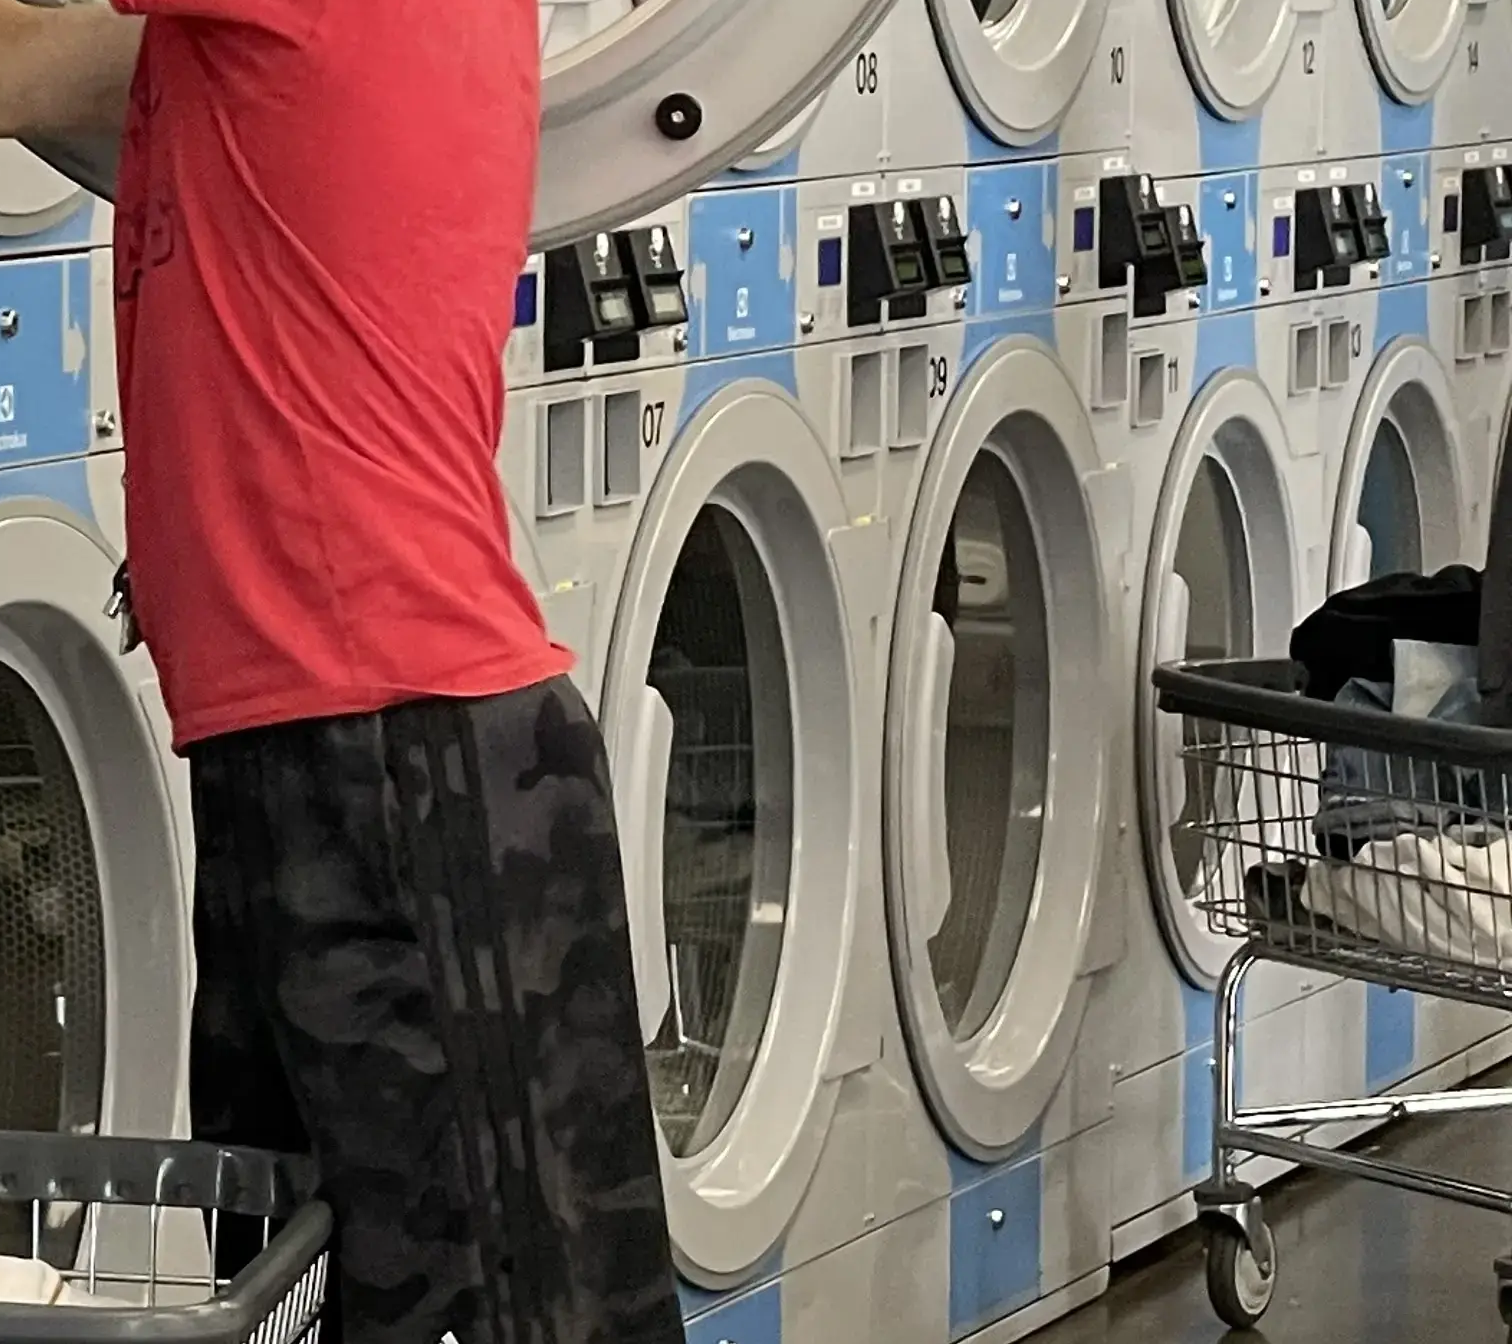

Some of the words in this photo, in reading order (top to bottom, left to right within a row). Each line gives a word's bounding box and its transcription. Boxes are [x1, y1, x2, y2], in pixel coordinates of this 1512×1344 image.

[856, 52, 878, 95] 08
[1110, 46, 1125, 84] 10
[1302, 40, 1315, 75] 12
[641, 401, 666, 448] 07
